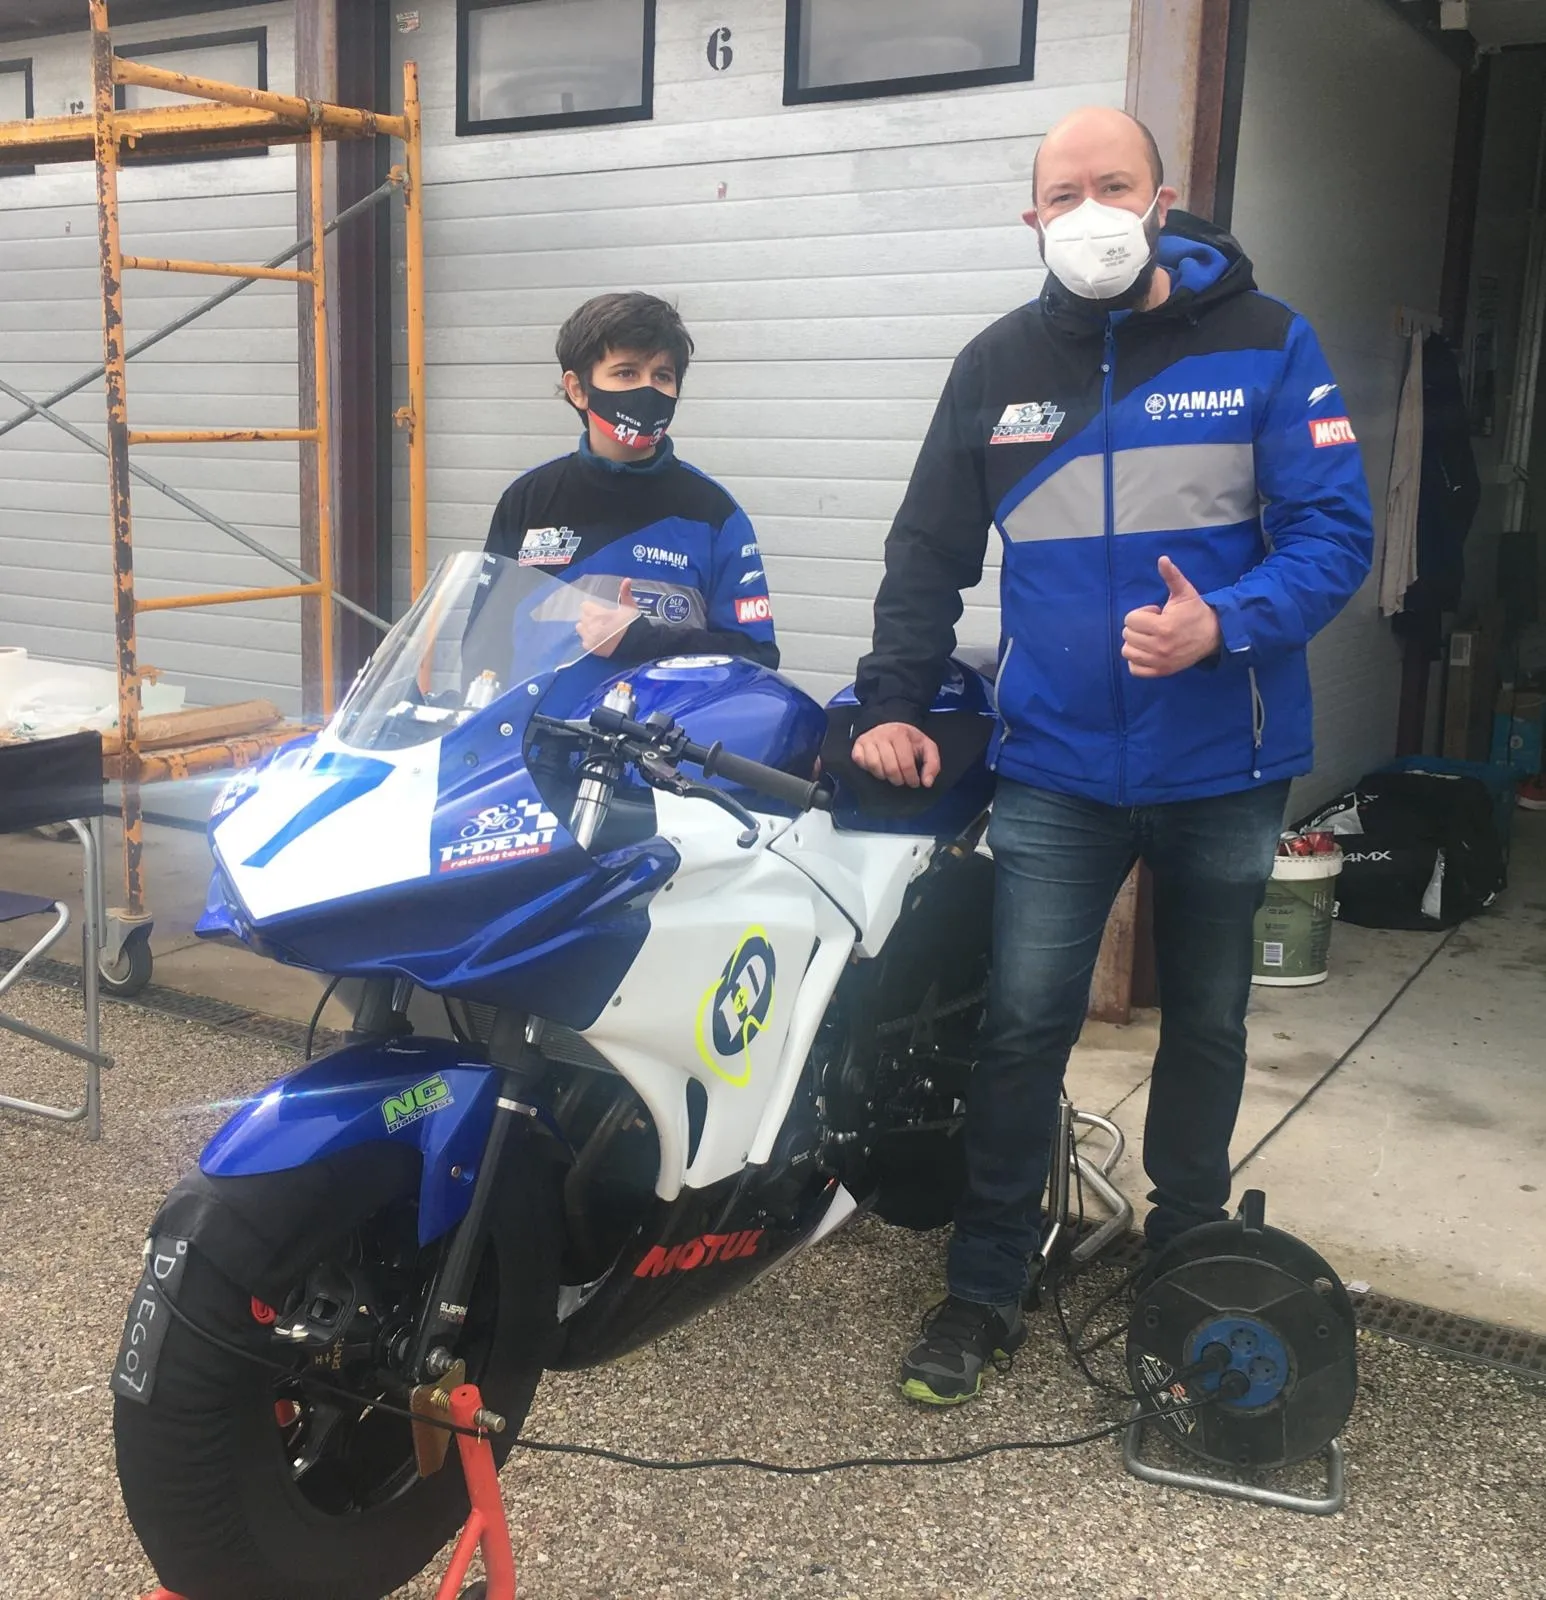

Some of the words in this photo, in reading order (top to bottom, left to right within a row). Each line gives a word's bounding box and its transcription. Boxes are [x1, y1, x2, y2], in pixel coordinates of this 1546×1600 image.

[706, 27, 733, 71] 6
[1167, 388, 1245, 412] YAMAHA
[1152, 410, 1239, 421] RACING
[613, 423, 639, 446] 47
[1314, 419, 1356, 445] MOTU
[646, 546, 689, 567] YAMAHA
[450, 853, 500, 868] racing
[501, 846, 540, 858] team
[383, 1075, 449, 1126] NG
[632, 1228, 766, 1278] MOTUL
